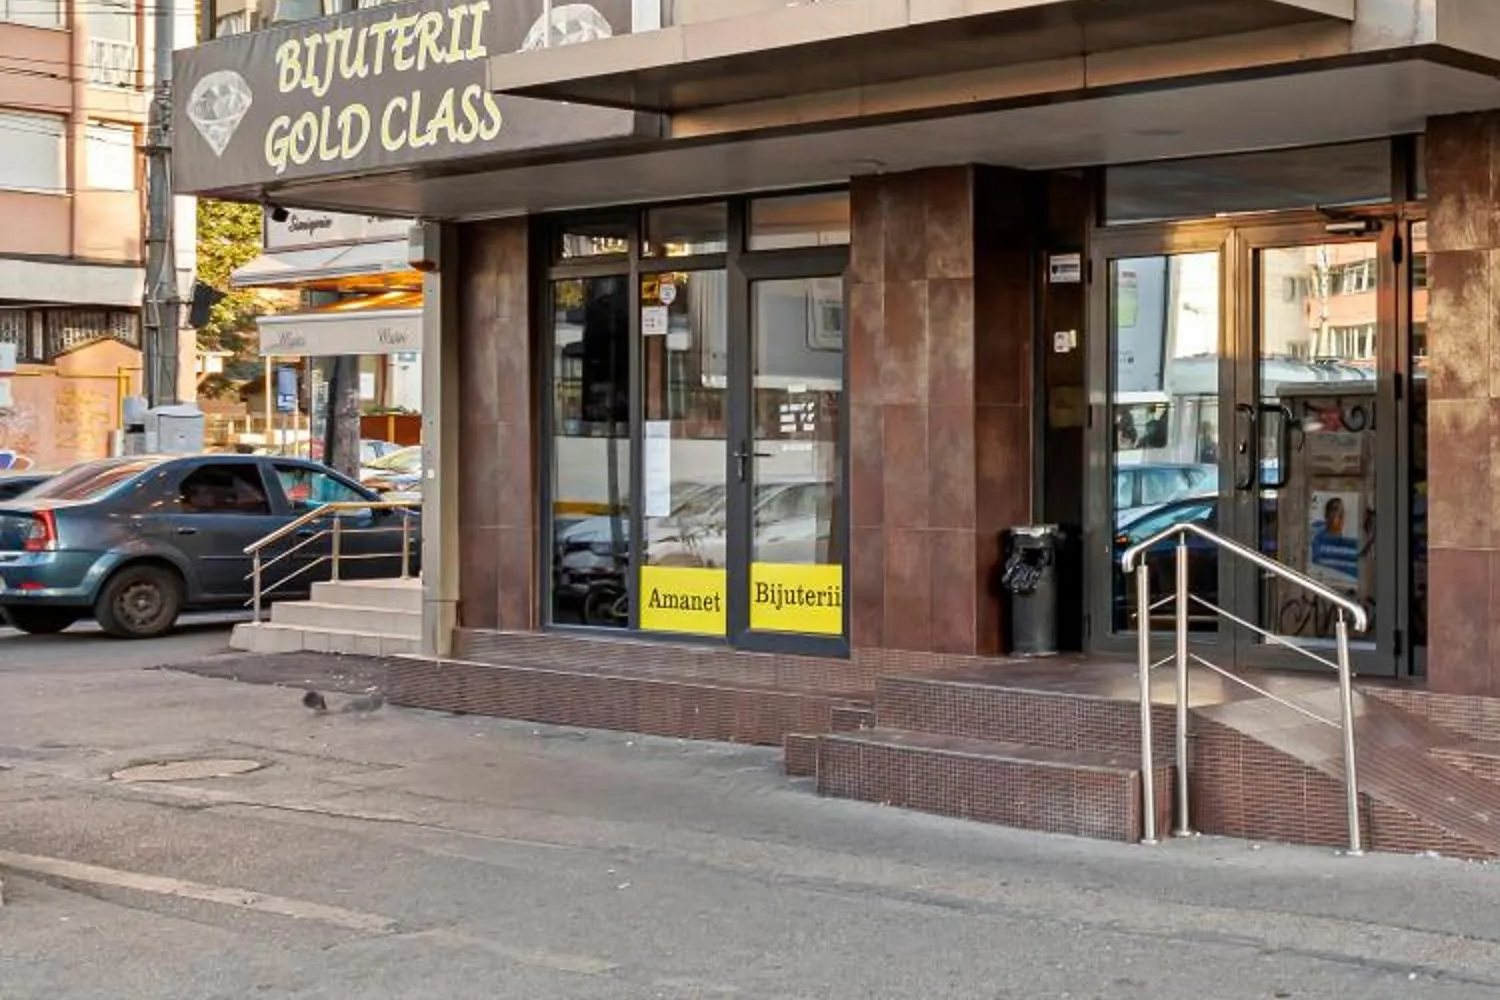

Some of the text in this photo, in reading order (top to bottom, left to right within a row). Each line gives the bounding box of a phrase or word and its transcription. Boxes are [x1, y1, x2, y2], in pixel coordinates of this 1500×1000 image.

[276, 0, 490, 98] BIJUTERII
[265, 84, 503, 175] GOLD CLASS
[649, 587, 721, 613] Amanet
[755, 582, 842, 610] Bijuterii
